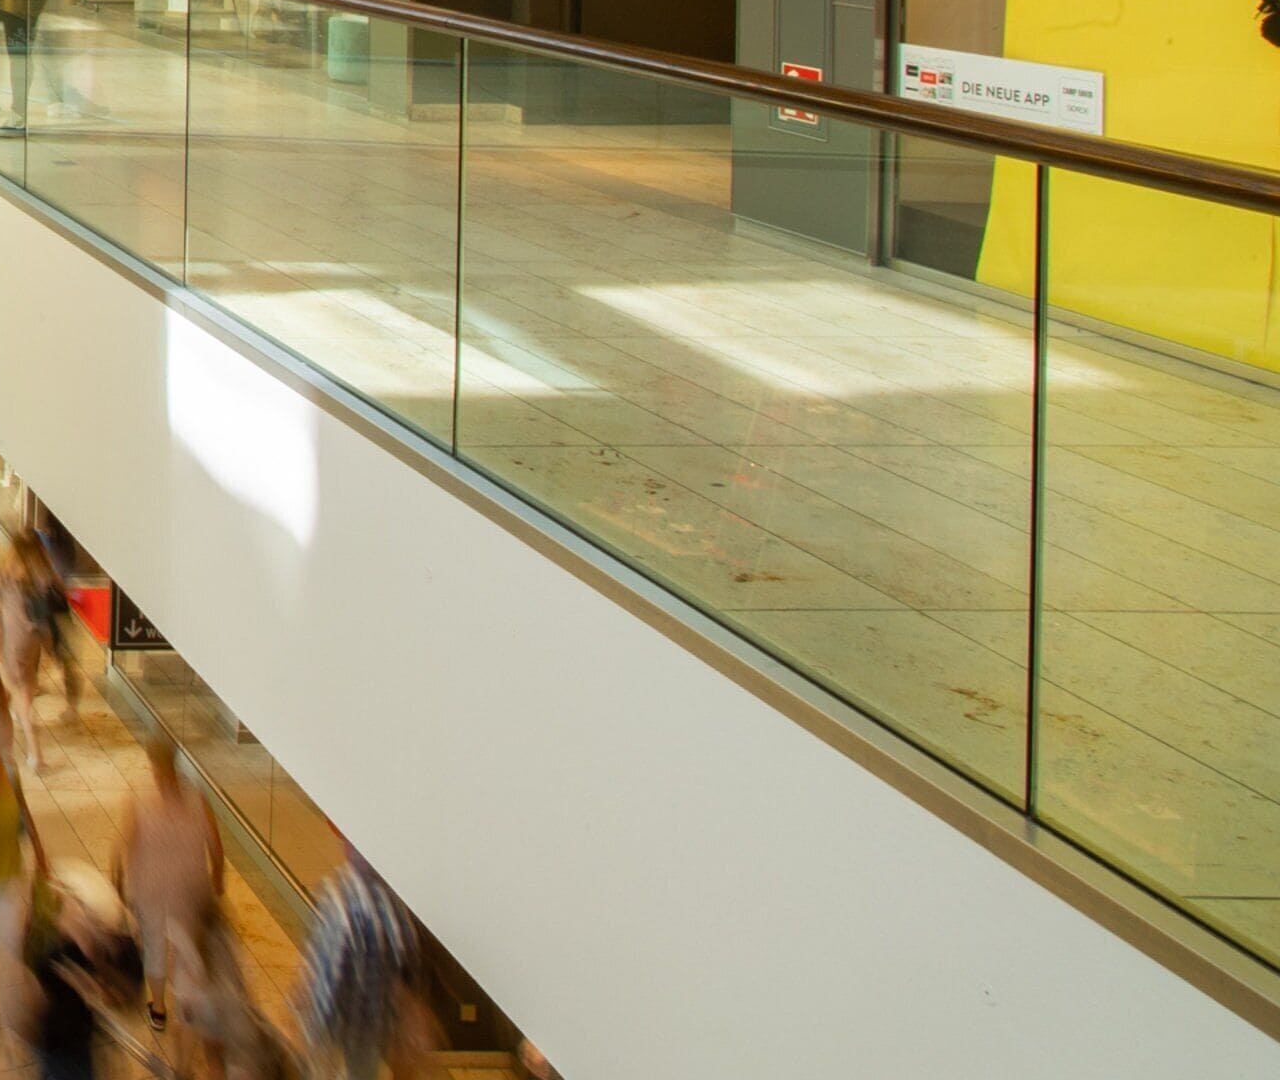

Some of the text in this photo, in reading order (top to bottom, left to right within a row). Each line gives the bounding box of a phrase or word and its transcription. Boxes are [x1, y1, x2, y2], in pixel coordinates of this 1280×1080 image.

[961, 81, 1050, 107] DIE NEUE APP
